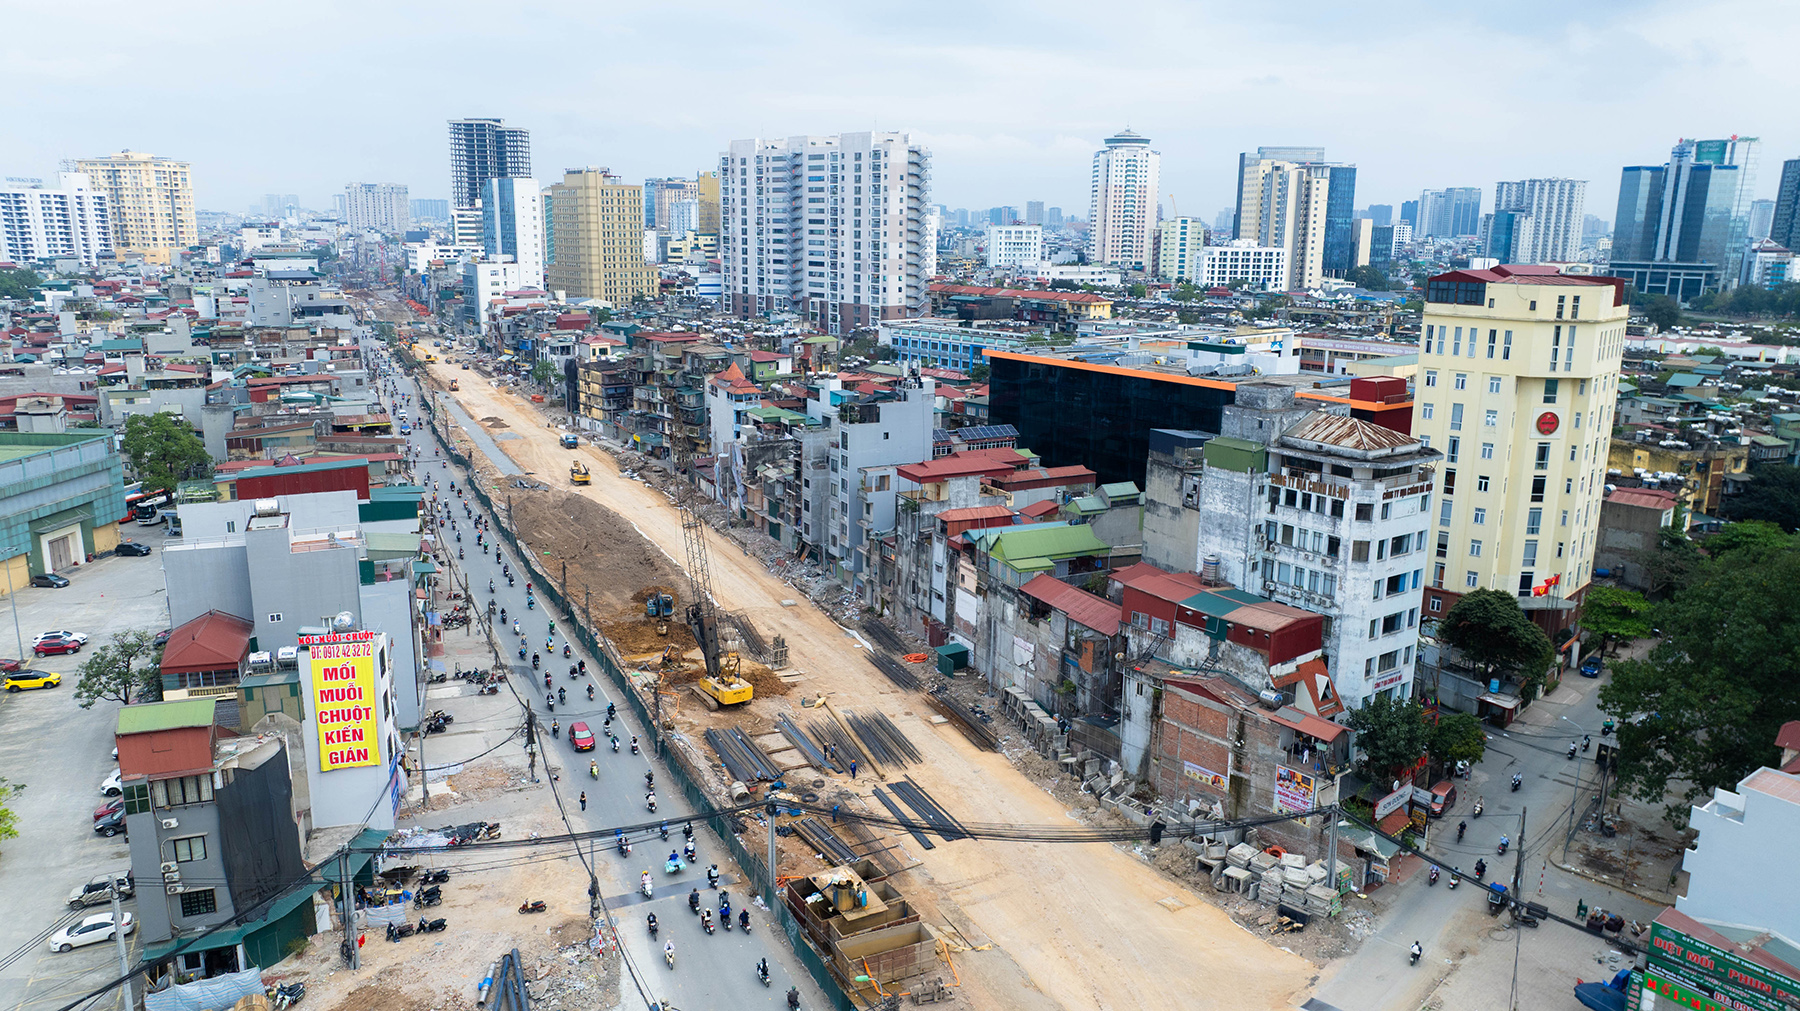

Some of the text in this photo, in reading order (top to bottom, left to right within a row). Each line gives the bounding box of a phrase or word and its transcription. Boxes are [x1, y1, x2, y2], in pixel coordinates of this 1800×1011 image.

[1288, 476, 1295, 488] TY
[310, 643, 371, 659] ĐT: 0912 42 32 72
[323, 661, 356, 681] MỐI
[319, 682, 363, 703] MUỖI
[318, 705, 372, 724] CHUỘT
[324, 725, 364, 745] KIẾN
[329, 747, 369, 765] GIÁN
[1695, 941, 1709, 950] DIỆT
[1710, 947, 1724, 957] MỐI
[1653, 935, 1684, 957] DIỆT
[1686, 950, 1715, 970] MỐI
[1727, 968, 1772, 993] PHUN
